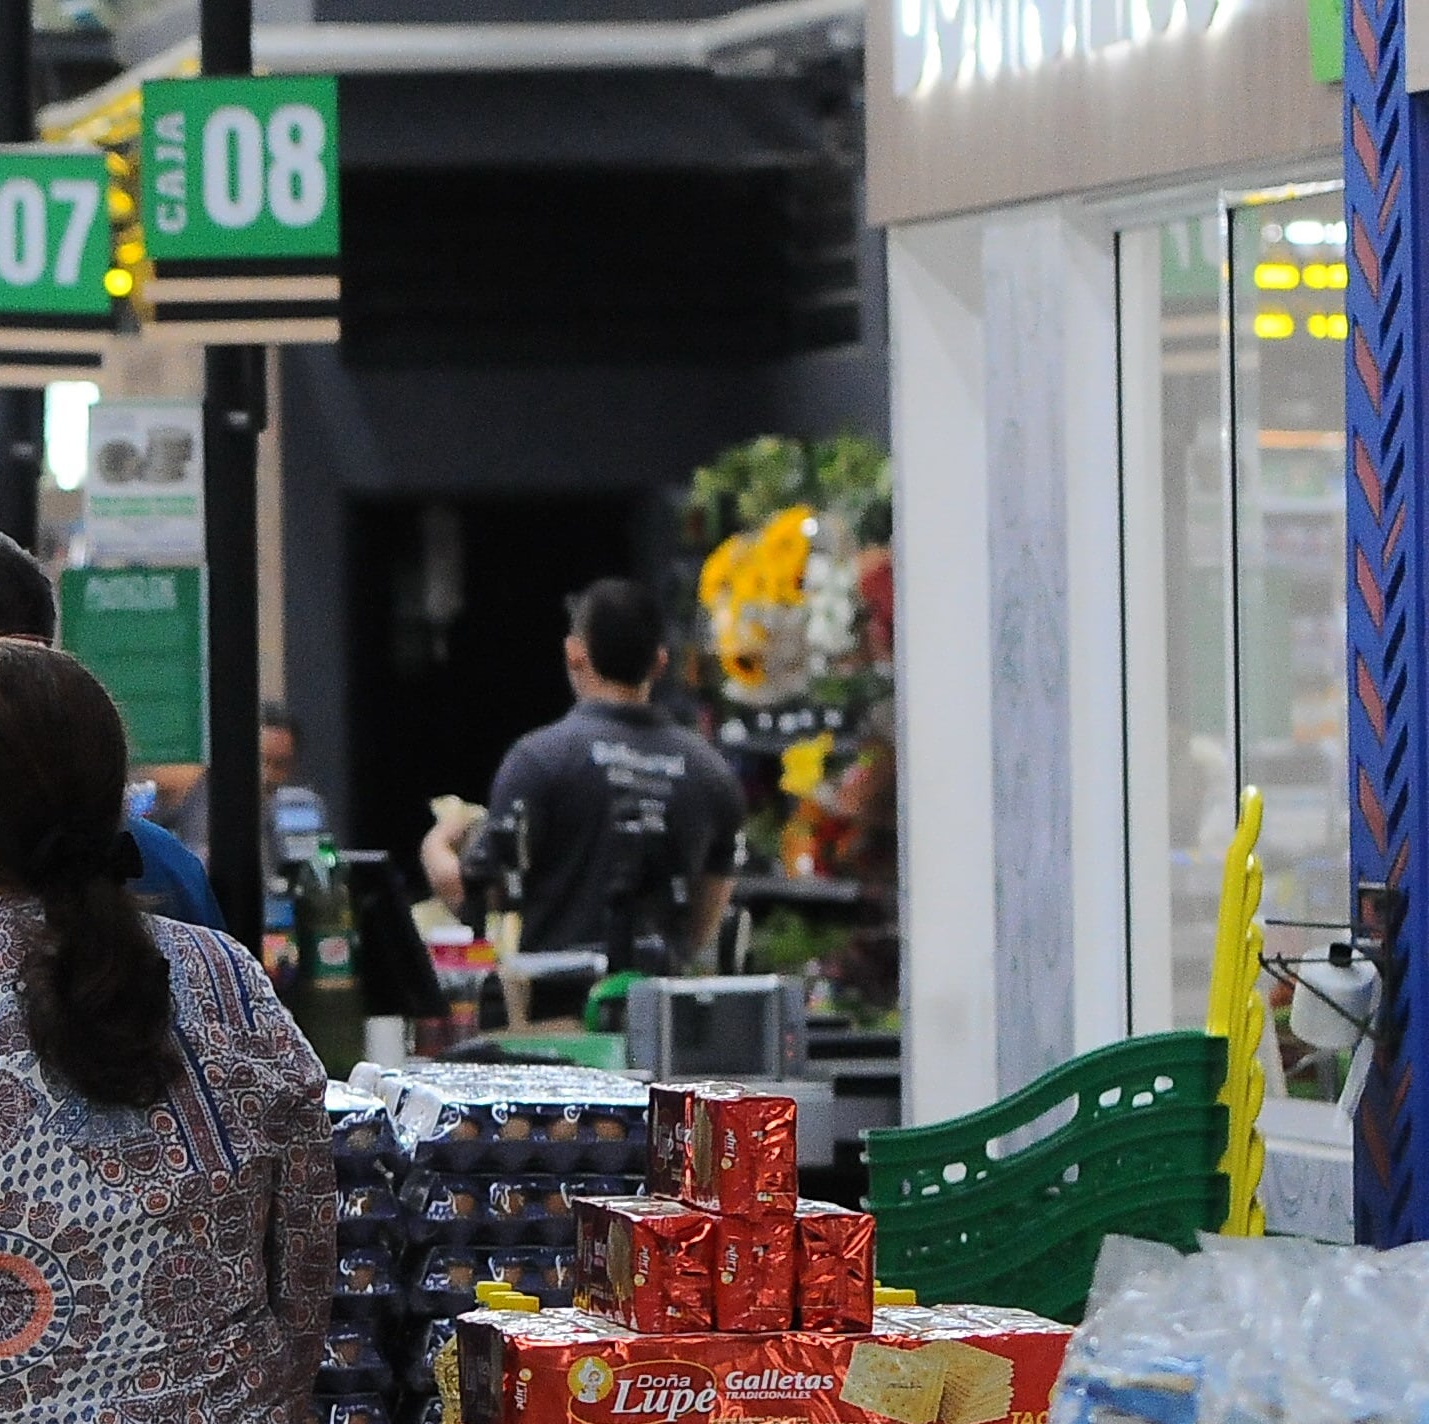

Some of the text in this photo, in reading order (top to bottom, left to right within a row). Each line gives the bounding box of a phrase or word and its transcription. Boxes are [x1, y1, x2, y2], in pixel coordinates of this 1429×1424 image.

[156, 112, 187, 235] CAJA
[203, 103, 327, 229] 08
[723, 1128, 738, 1158] Lupe
[725, 1243, 739, 1273] Lupe
[514, 1380, 528, 1411] Lupe
[636, 1373, 690, 1389] Doña
[725, 1370, 833, 1391] Galletas
[725, 1391, 811, 1400] TRADICIONALES
[611, 1379, 717, 1422] Lupe
